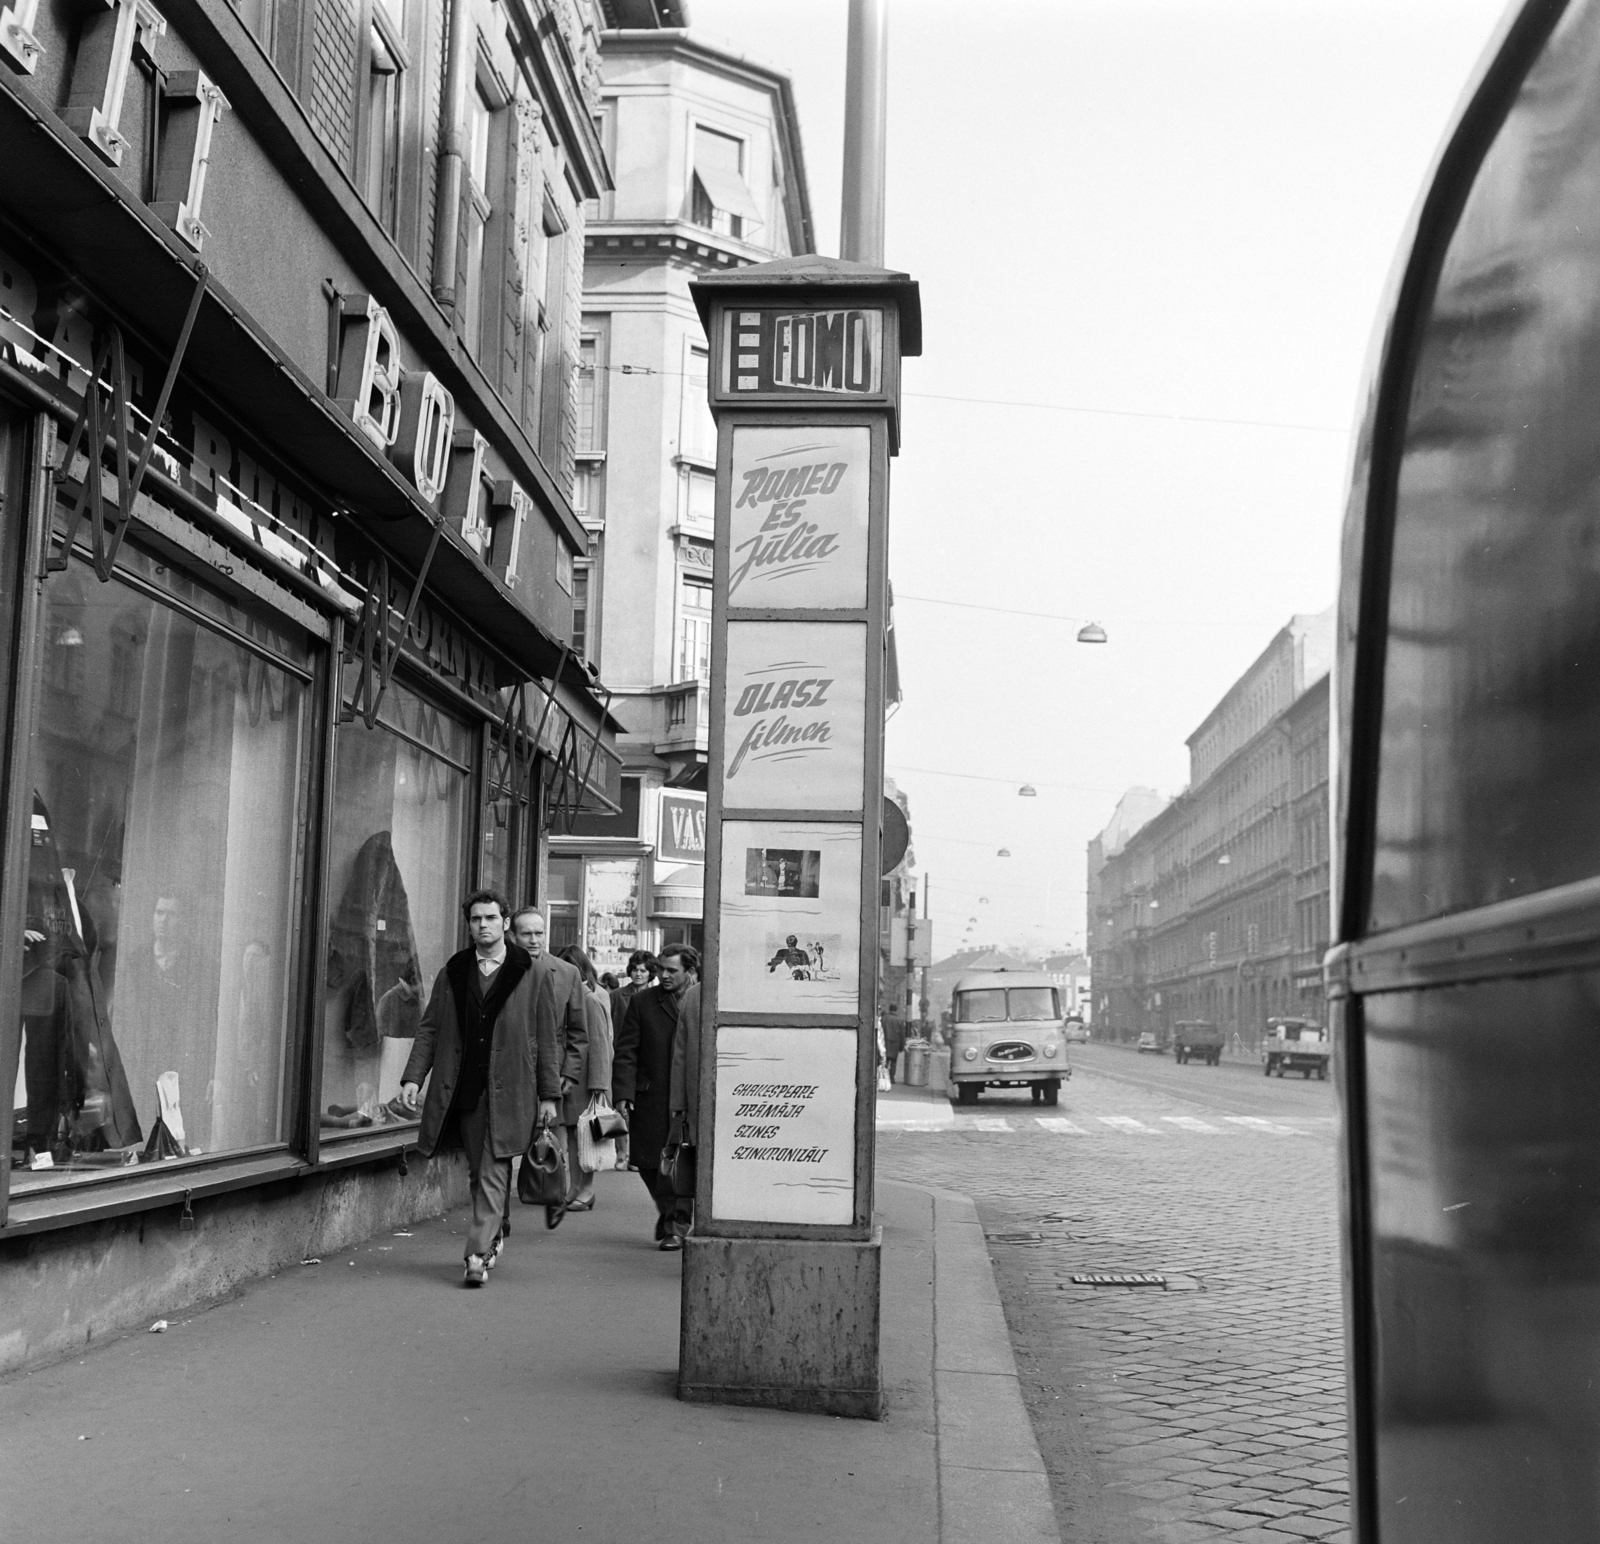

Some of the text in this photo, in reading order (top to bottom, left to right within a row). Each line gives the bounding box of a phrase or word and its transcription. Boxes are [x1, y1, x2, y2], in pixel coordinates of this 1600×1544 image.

[346, 294, 533, 589] BOLT
[190, 411, 338, 584] RUHA
[735, 462, 848, 509] ROMEO
[759, 498, 807, 532] ÉS
[733, 678, 834, 717] OLASZ
[732, 1083, 819, 1099] SHAKESPEARE
[735, 1101, 806, 1118] DRÁMÁJA
[734, 1124, 780, 1139] SZINES
[731, 1145, 829, 1163] SZINKRONIZÁLT
